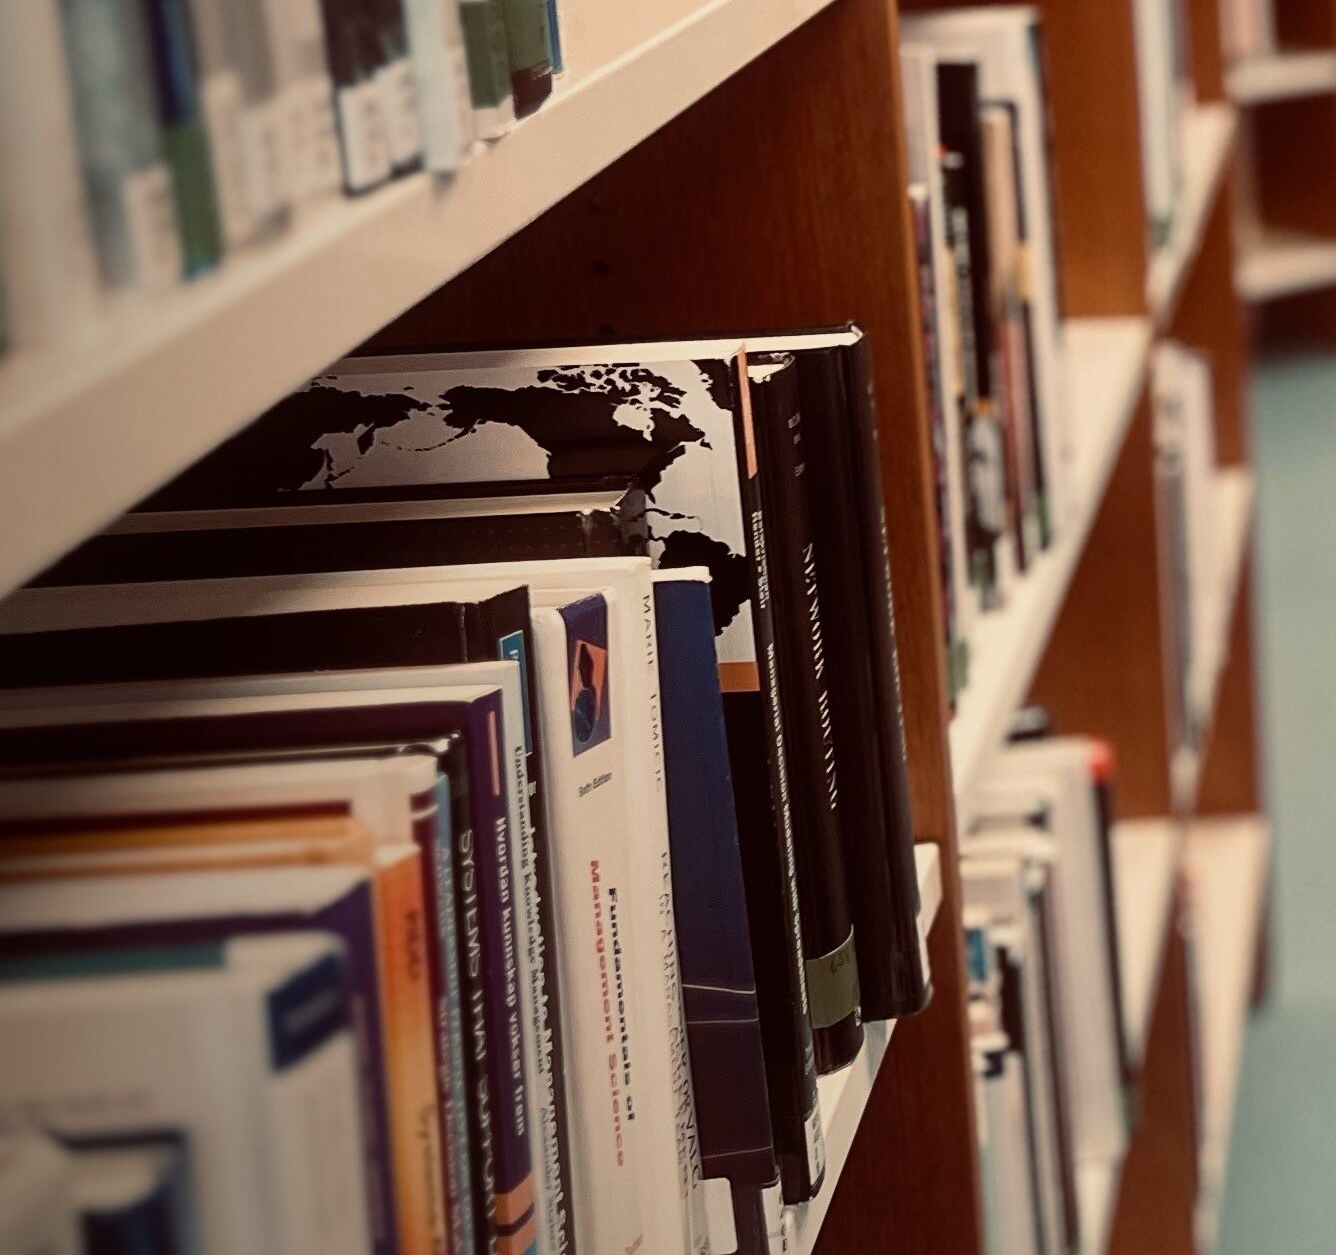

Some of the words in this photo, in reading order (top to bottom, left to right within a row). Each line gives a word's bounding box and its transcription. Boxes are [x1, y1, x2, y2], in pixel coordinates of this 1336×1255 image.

[459, 829, 480, 978] SYSTEMS
[495, 816, 510, 903] Hvordan
[514, 745, 530, 869] Understanding
[523, 872, 535, 964] Knowledge
[531, 968, 545, 1074] Management
[502, 907, 516, 1007] kunnskap
[590, 859, 615, 1043] Management
[608, 1052, 624, 1167] Science
[608, 887, 631, 1086] Fundamentals
[626, 1095, 636, 1121] of
